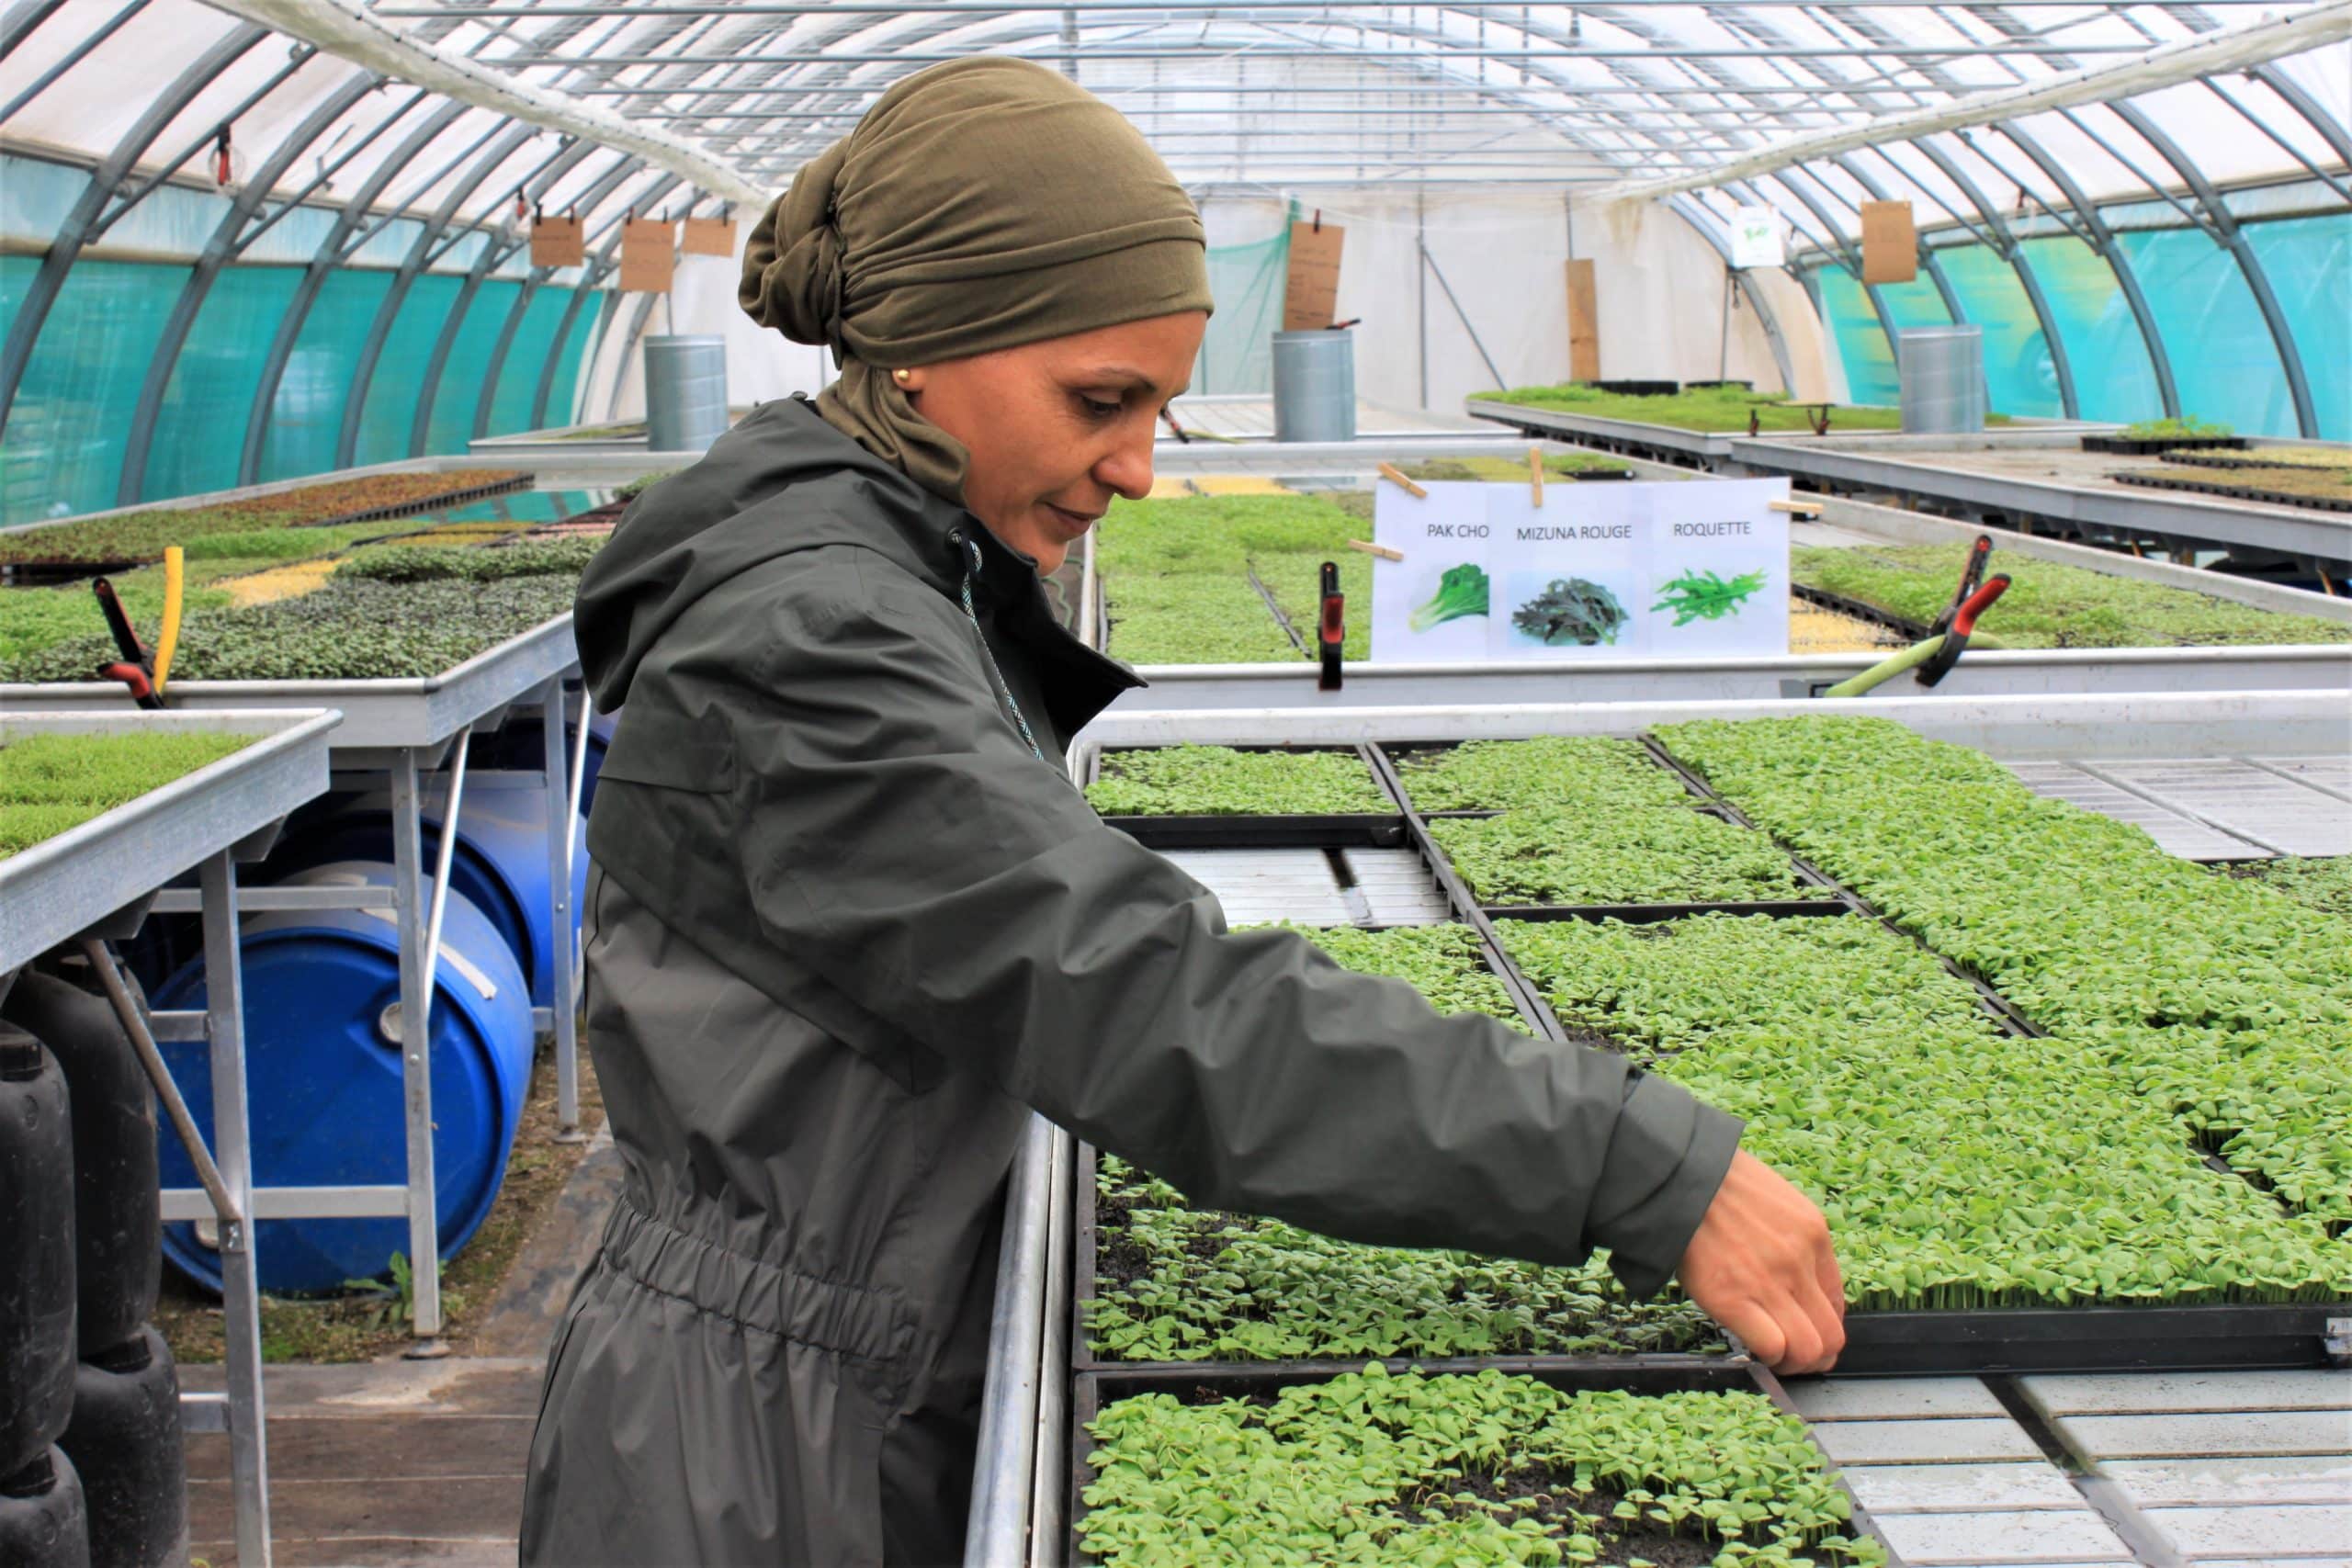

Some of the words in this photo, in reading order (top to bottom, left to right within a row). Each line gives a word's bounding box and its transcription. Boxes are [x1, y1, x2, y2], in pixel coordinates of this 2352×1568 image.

[1427, 525, 1453, 537] PAK
[1457, 525, 1489, 538] CHO
[1517, 526, 1577, 540] MIZUNA
[1581, 525, 1632, 539] ROUGE
[1674, 522, 1750, 536] ROQUETTE
